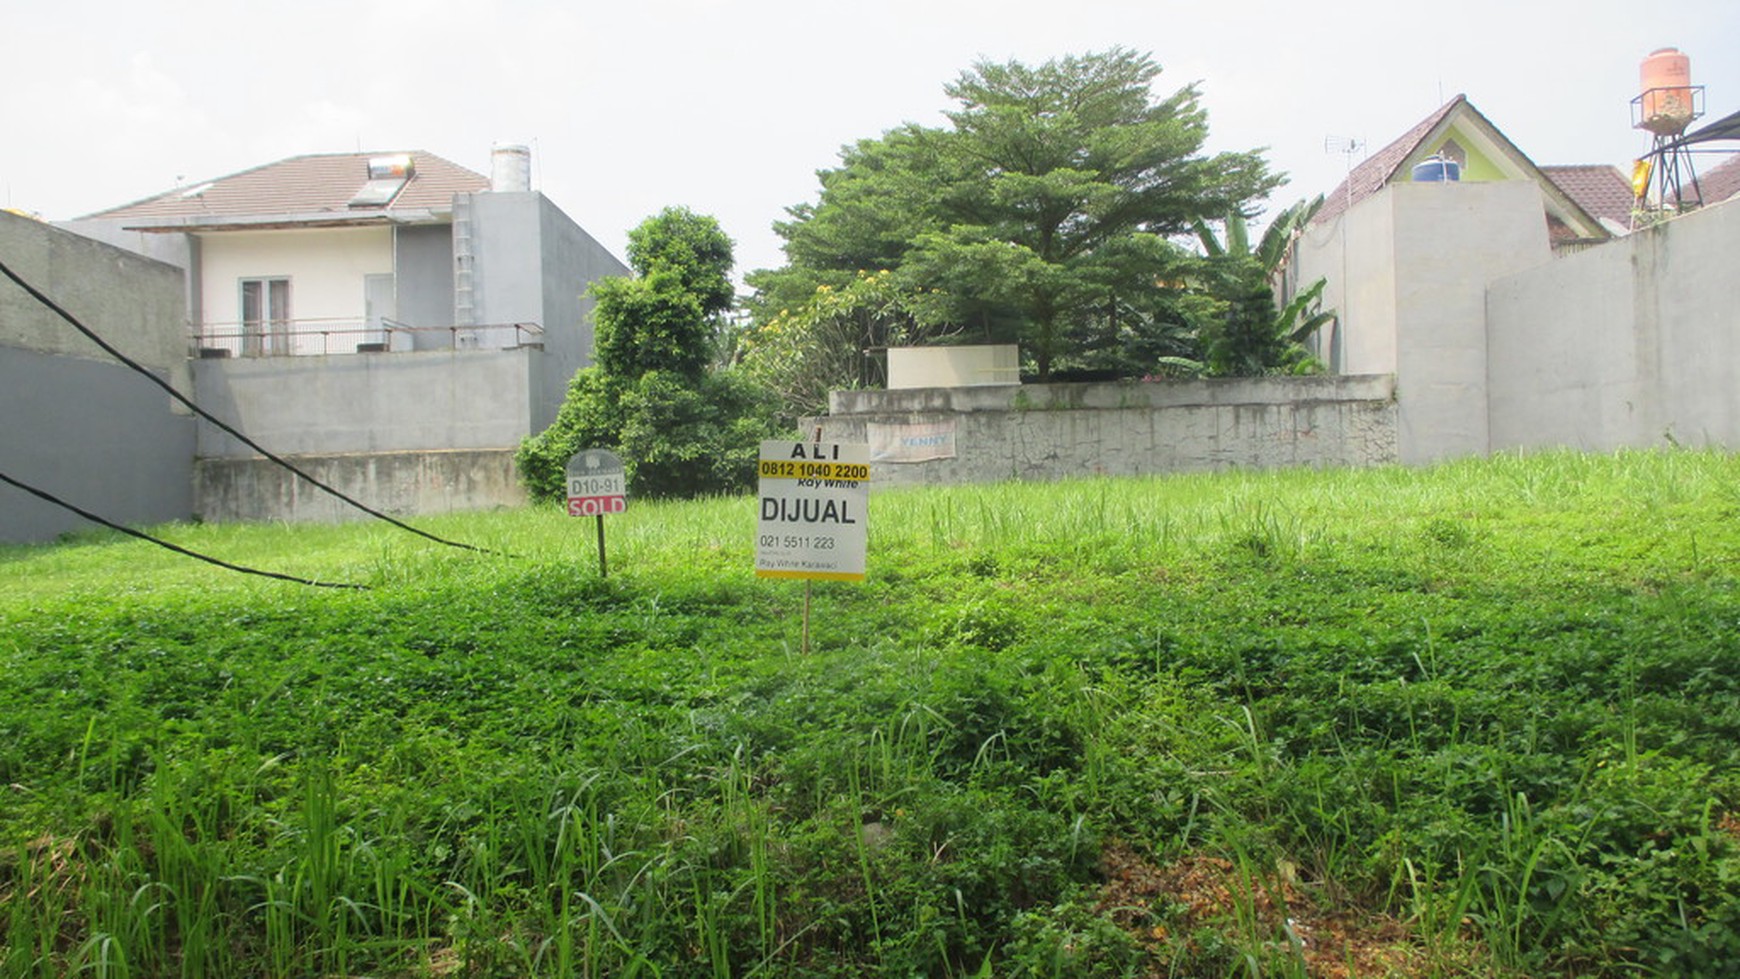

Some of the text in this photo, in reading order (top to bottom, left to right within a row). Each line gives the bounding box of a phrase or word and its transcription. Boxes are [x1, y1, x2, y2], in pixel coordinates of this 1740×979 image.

[791, 443, 839, 460] ALI
[762, 462, 867, 478] 0812 1040 2200
[572, 478, 619, 494] D10-91
[797, 479, 859, 489] Ray White
[569, 498, 626, 515] SOLD
[762, 497, 856, 524] DIJUAL
[760, 535, 836, 550] 021 5511 223
